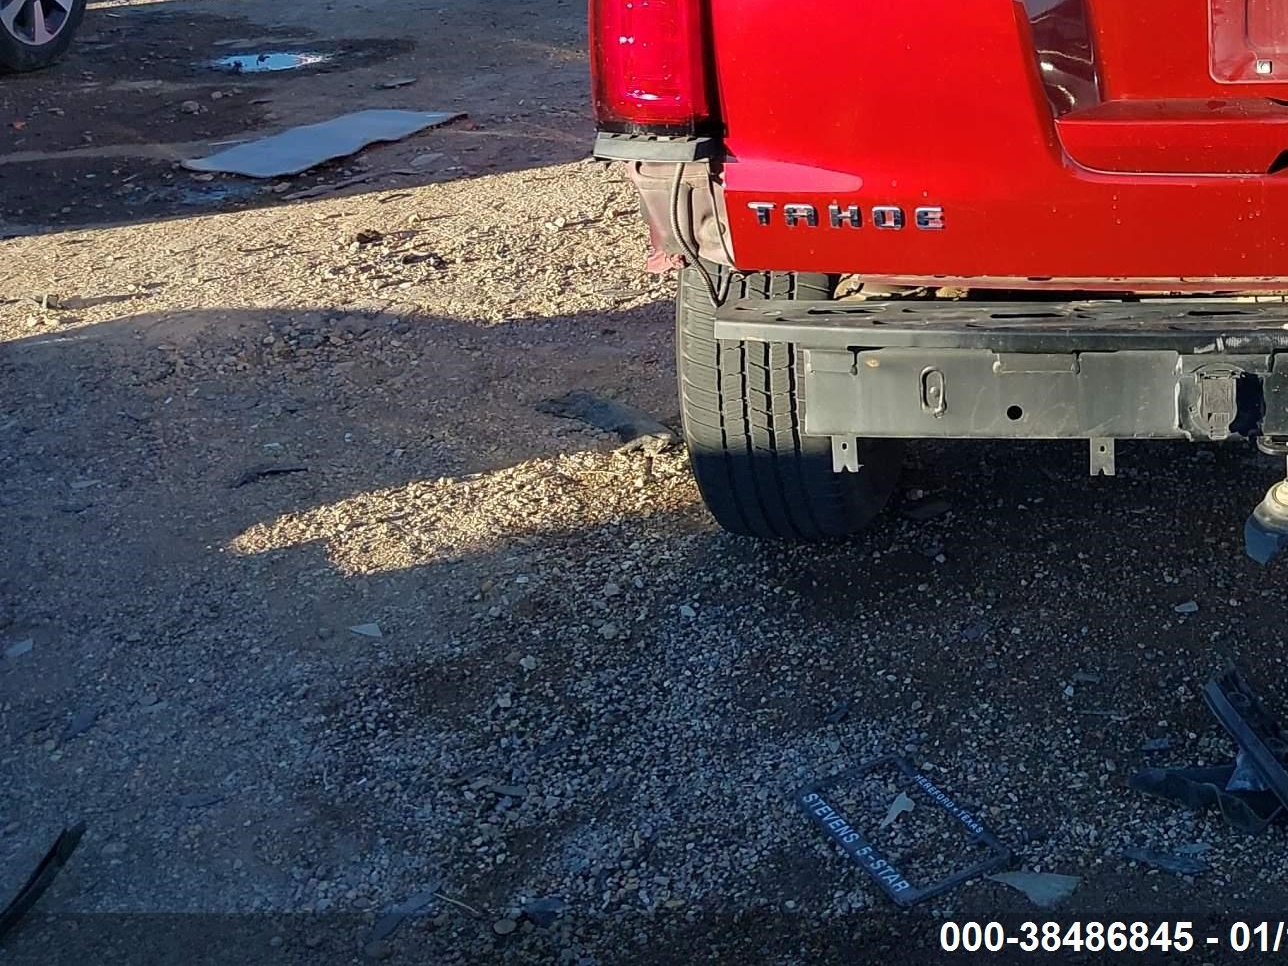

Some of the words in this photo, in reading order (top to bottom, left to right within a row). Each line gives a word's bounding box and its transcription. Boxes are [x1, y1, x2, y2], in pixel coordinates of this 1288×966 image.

[747, 202, 945, 229] TAHOE
[914, 774, 955, 809] HEREFORD
[958, 810, 984, 834] TEXAS
[803, 793, 860, 844] STEVENS
[856, 846, 910, 892] 5-STAR
